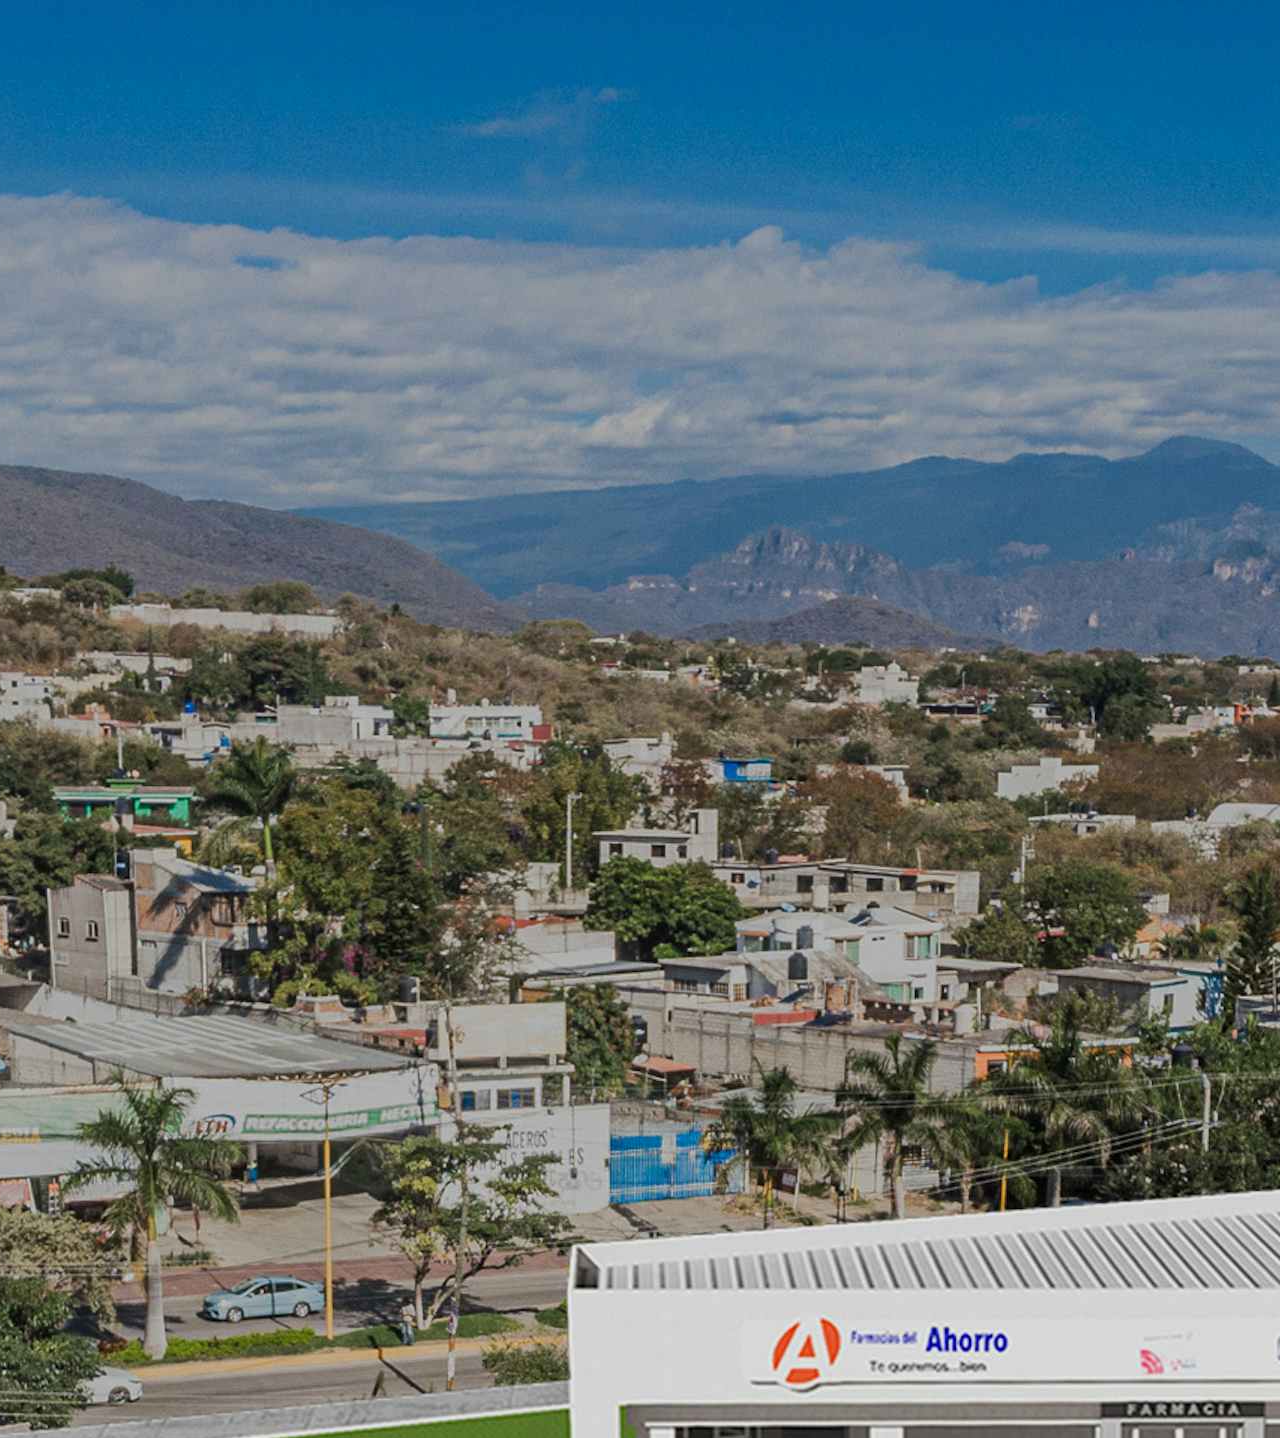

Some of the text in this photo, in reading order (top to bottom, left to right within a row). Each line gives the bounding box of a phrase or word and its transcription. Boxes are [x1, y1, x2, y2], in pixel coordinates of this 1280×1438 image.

[505, 1130, 548, 1149] ACEROS
[926, 1327, 1008, 1352] Ahorro
[870, 1360, 885, 1372] Te
[1126, 1402, 1241, 1417] FARMACIA
